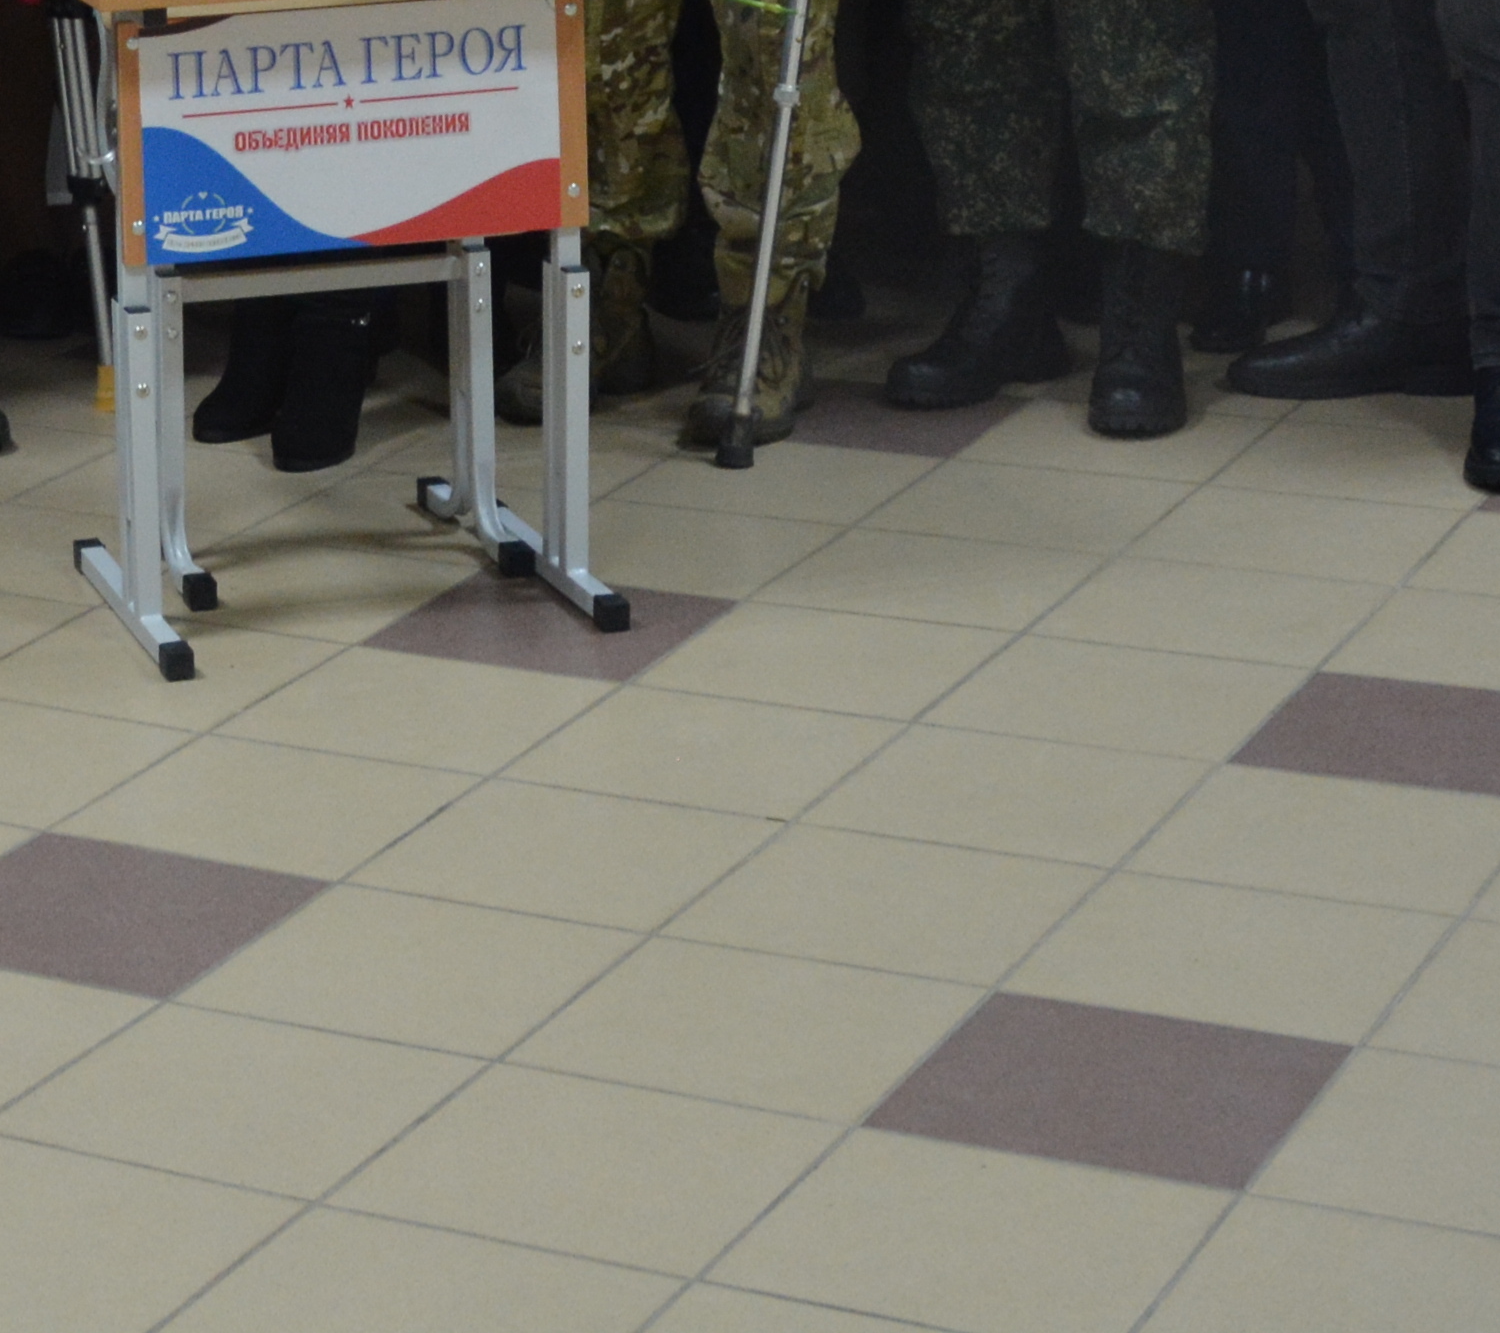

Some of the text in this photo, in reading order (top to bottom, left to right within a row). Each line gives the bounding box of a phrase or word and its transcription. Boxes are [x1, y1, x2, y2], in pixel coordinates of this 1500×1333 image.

[168, 24, 527, 100] ПАРТА ГЕРОЯ
[234, 112, 469, 152] ОБЪЕДИНЯЯ ПОКОЛЕНИЯ
[163, 205, 243, 224] ПАРТА ГЕРОЯ
